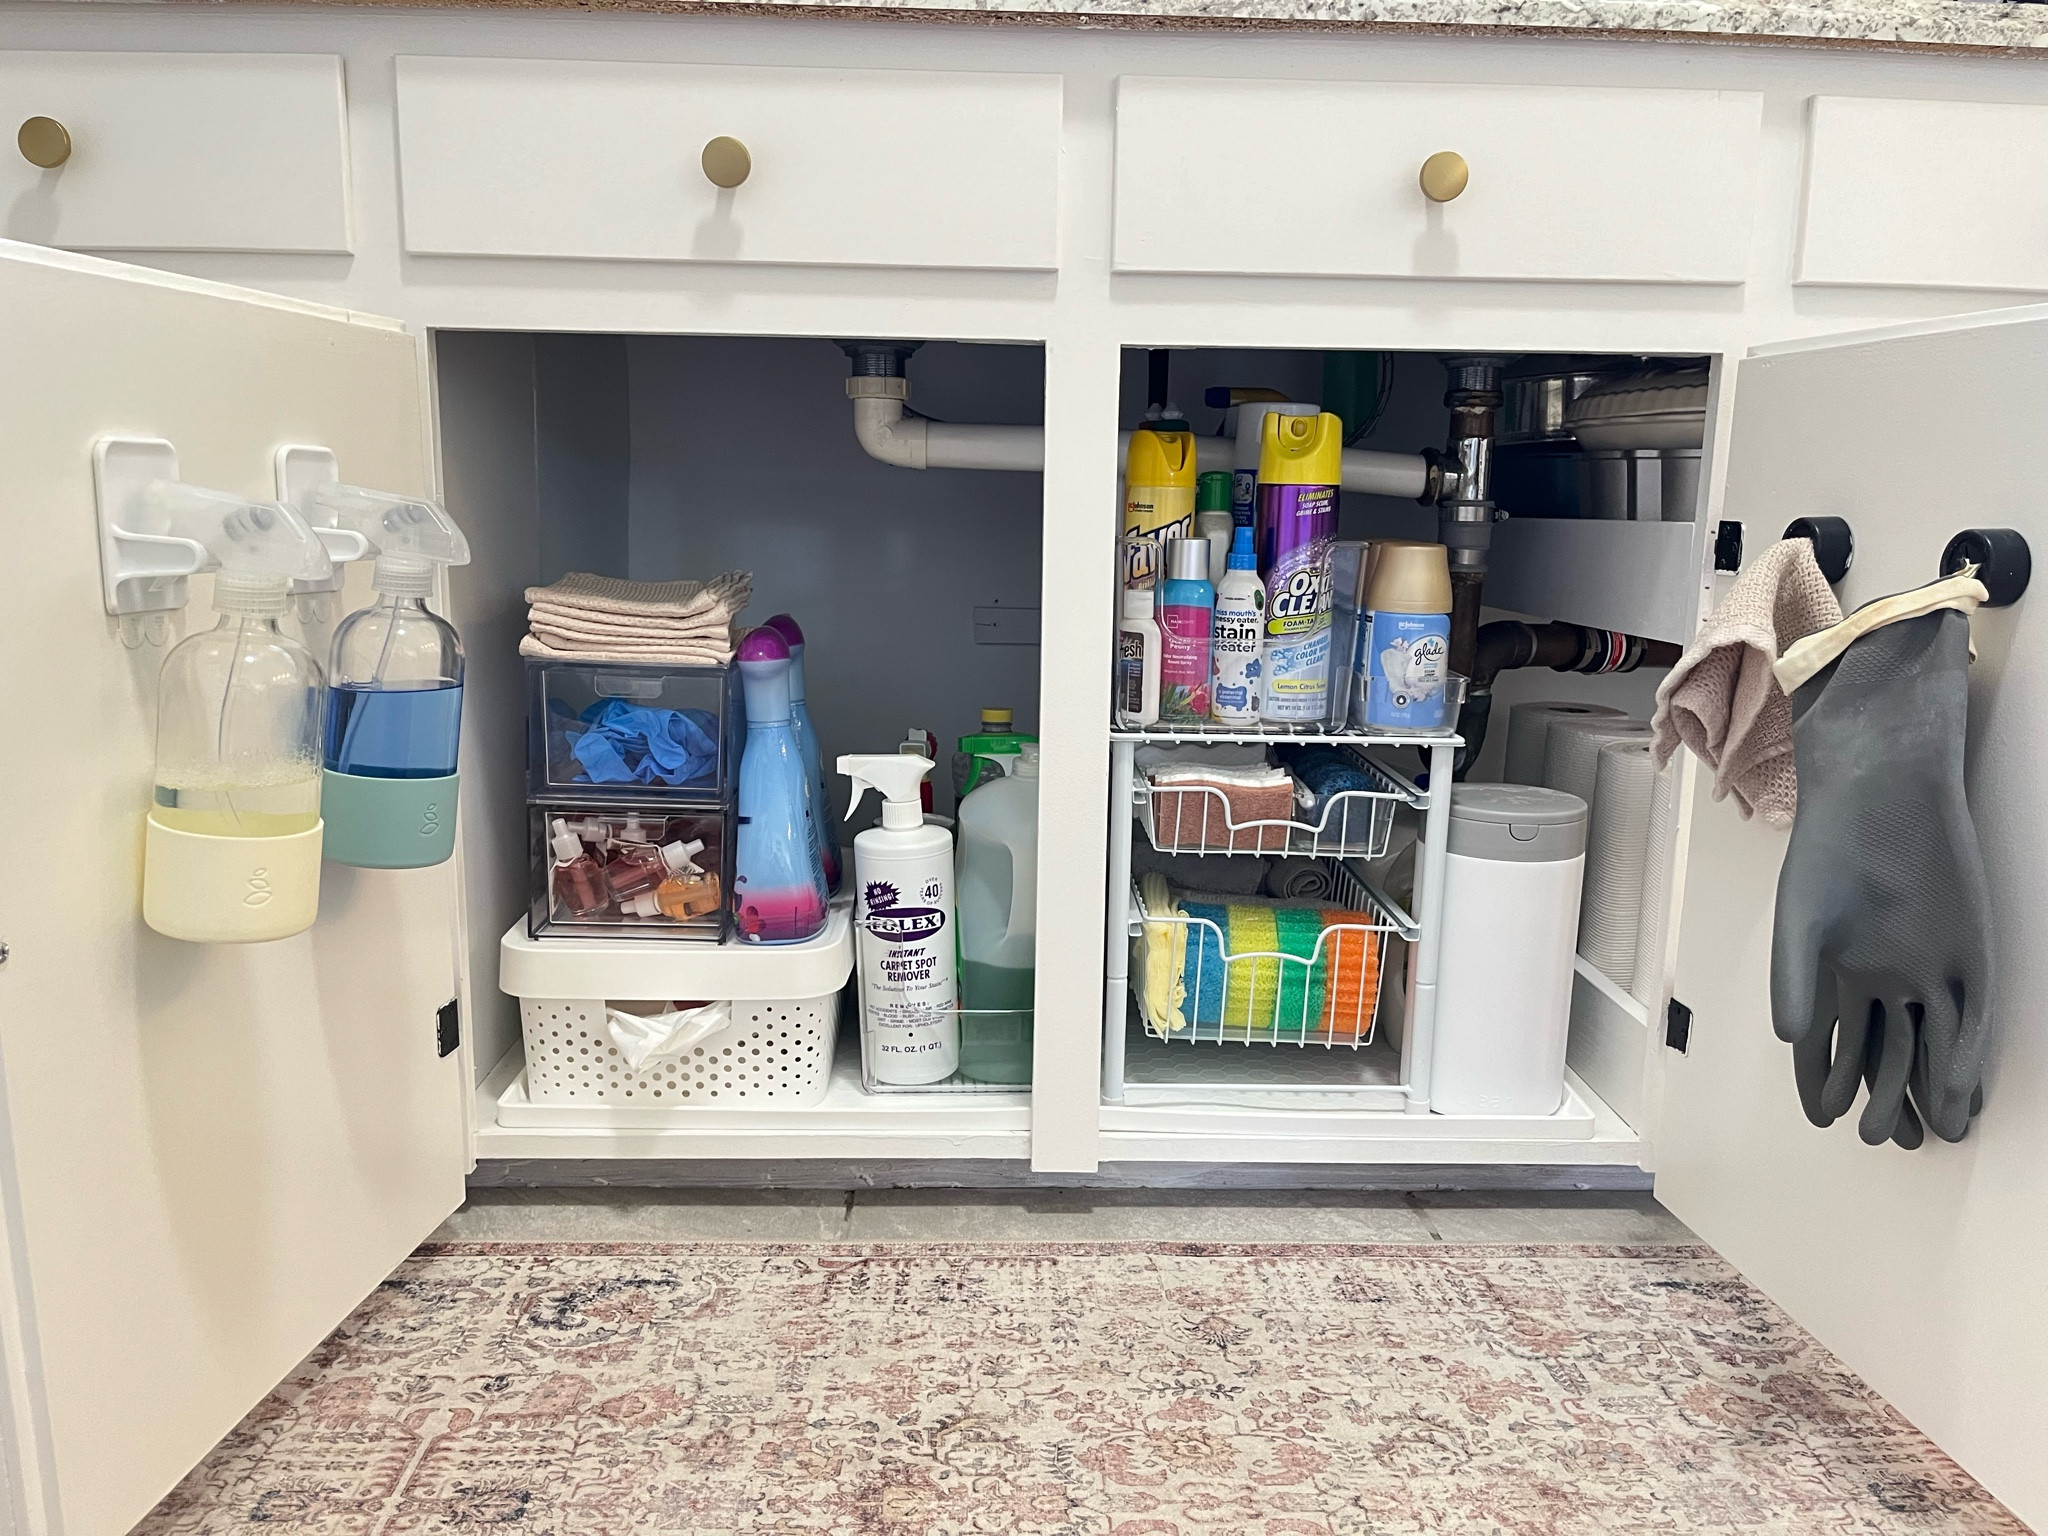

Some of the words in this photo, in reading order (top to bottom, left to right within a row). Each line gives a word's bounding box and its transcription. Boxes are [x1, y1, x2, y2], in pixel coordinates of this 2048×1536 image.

[1298, 489, 1334, 502] ELIMINATES
[1214, 623, 1256, 640] stain
[1214, 642, 1256, 652] treater
[1295, 647, 1318, 661] COLOR
[1414, 642, 1445, 665] glade
[1278, 682, 1298, 690] Lemon
[1299, 682, 1315, 690] Citrus
[873, 887, 882, 896] NO
[925, 884, 939, 899] 40
[869, 892, 895, 906] RINSING!
[880, 960, 912, 971] CARPET
[915, 956, 937, 970] SPOT
[887, 969, 931, 982] REMOVER
